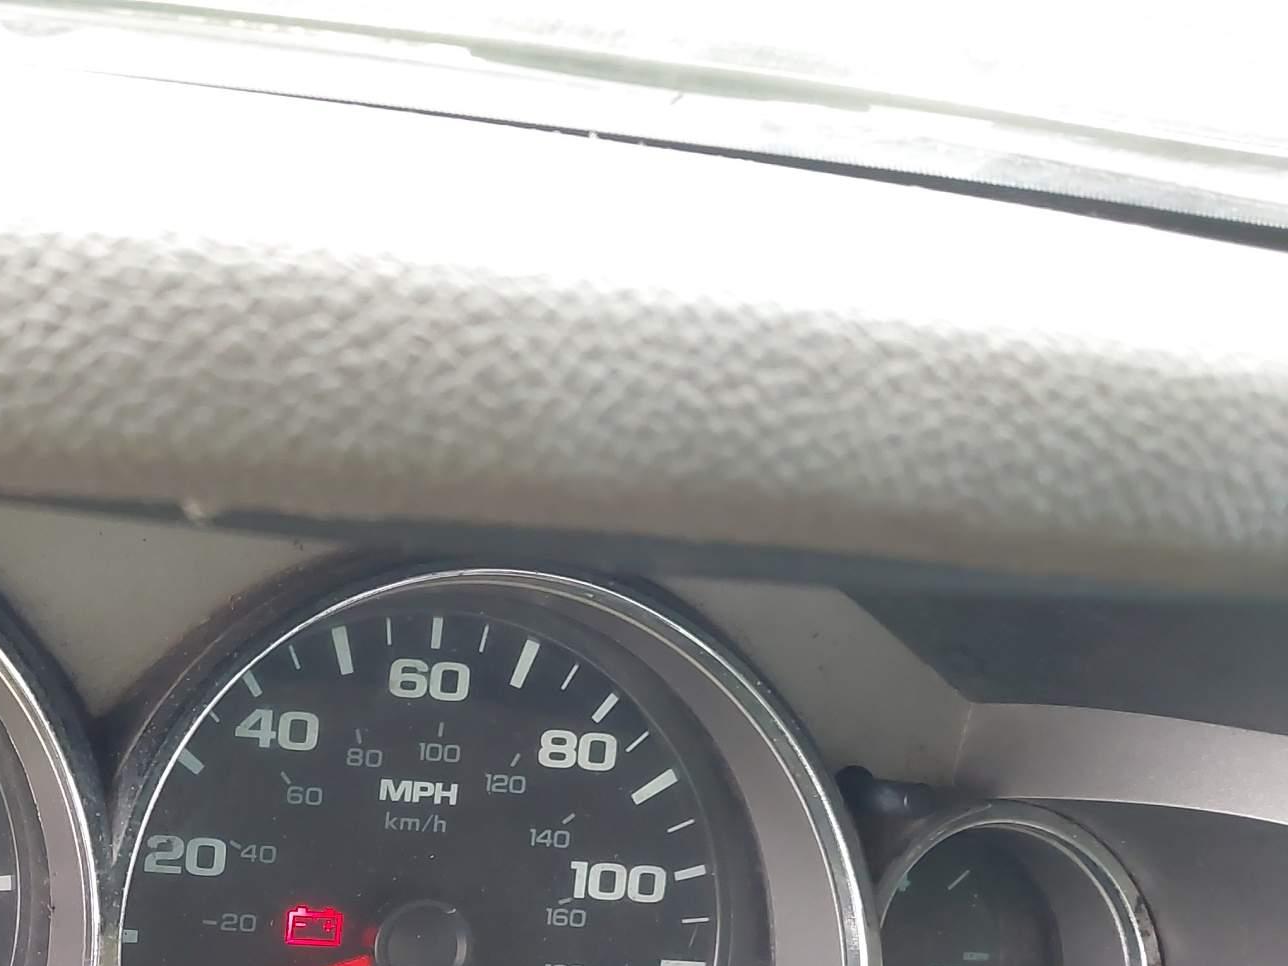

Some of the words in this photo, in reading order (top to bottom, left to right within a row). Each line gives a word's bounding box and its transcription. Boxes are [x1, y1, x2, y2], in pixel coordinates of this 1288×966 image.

[388, 658, 471, 702] 60
[234, 708, 320, 751] 40
[346, 748, 383, 768] 80
[419, 742, 461, 763] 100
[538, 729, 617, 771] 80
[378, 778, 459, 806] MPH
[485, 773, 527, 794] 120
[286, 786, 323, 806] 60
[385, 811, 447, 833] km/h
[529, 828, 570, 849] 140
[143, 834, 227, 877] 20
[240, 843, 277, 864] 40
[570, 861, 666, 903] 100
[220, 913, 257, 933] 20
[545, 907, 586, 928] 160
